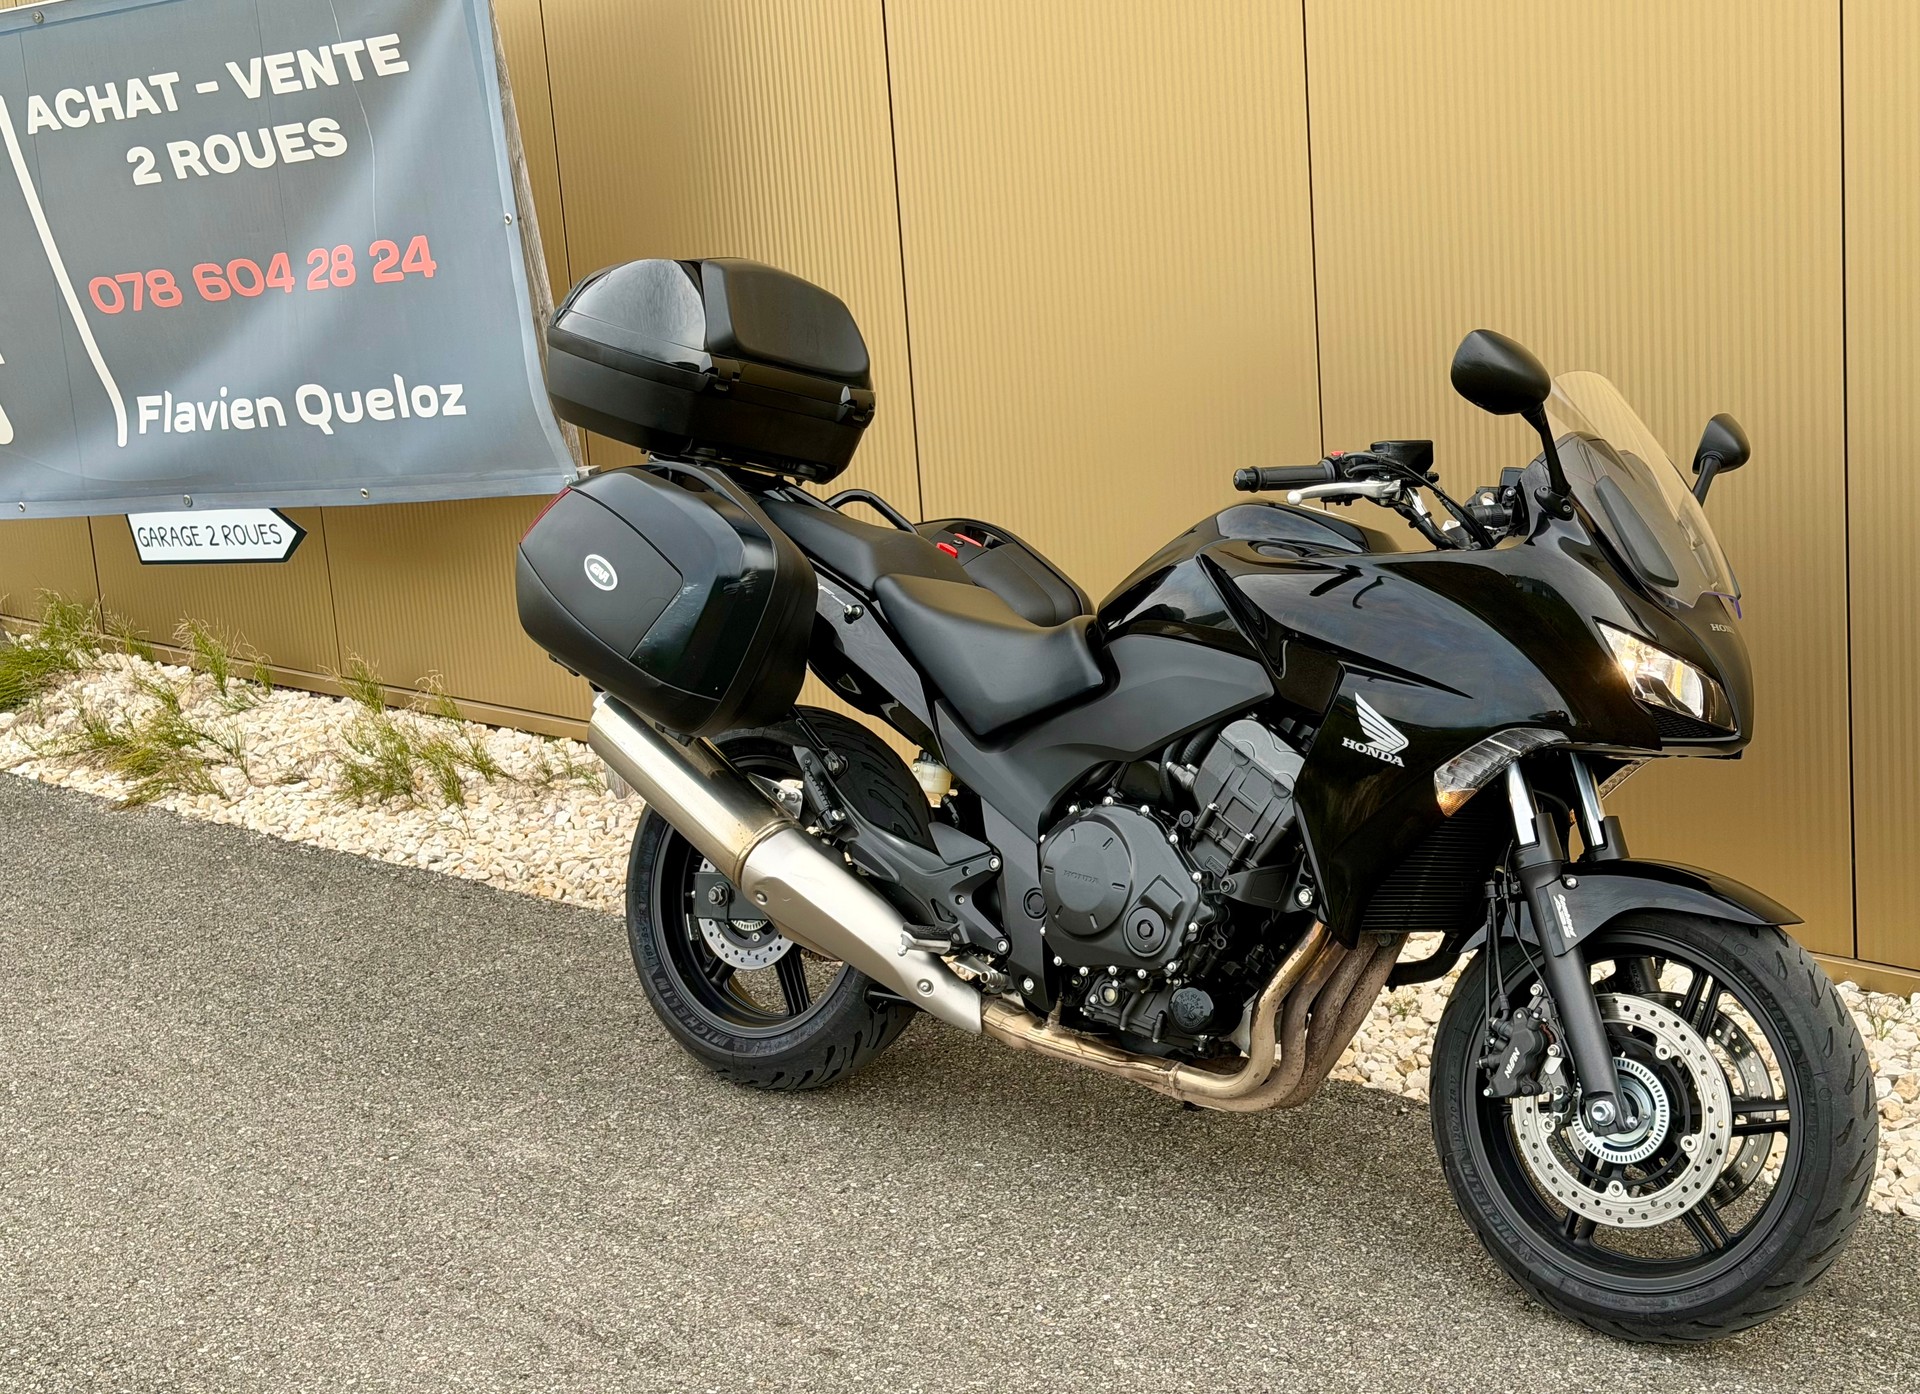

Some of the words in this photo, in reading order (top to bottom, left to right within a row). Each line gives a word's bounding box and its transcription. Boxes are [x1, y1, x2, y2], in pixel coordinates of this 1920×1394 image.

[27, 72, 180, 135] ACHAT
[195, 80, 219, 94] -
[225, 33, 410, 99] VENTE
[126, 146, 162, 186] 2
[166, 117, 348, 180] ROUES
[88, 269, 183, 314] 078
[192, 252, 295, 302] 604
[306, 244, 357, 291] 28
[369, 235, 437, 284] 24
[136, 386, 287, 434] Flavien
[295, 373, 467, 435] Queloz
[137, 525, 203, 548] GARAGE
[205, 525, 220, 547] 2
[221, 523, 283, 547] ROUES
[1710, 623, 1735, 634] HON
[1341, 736, 1405, 768] HONDA
[654, 976, 731, 1047] MICHELIN
[1738, 967, 1801, 1052] MICHELIN
[1461, 1162, 1519, 1244] MICHELIN
